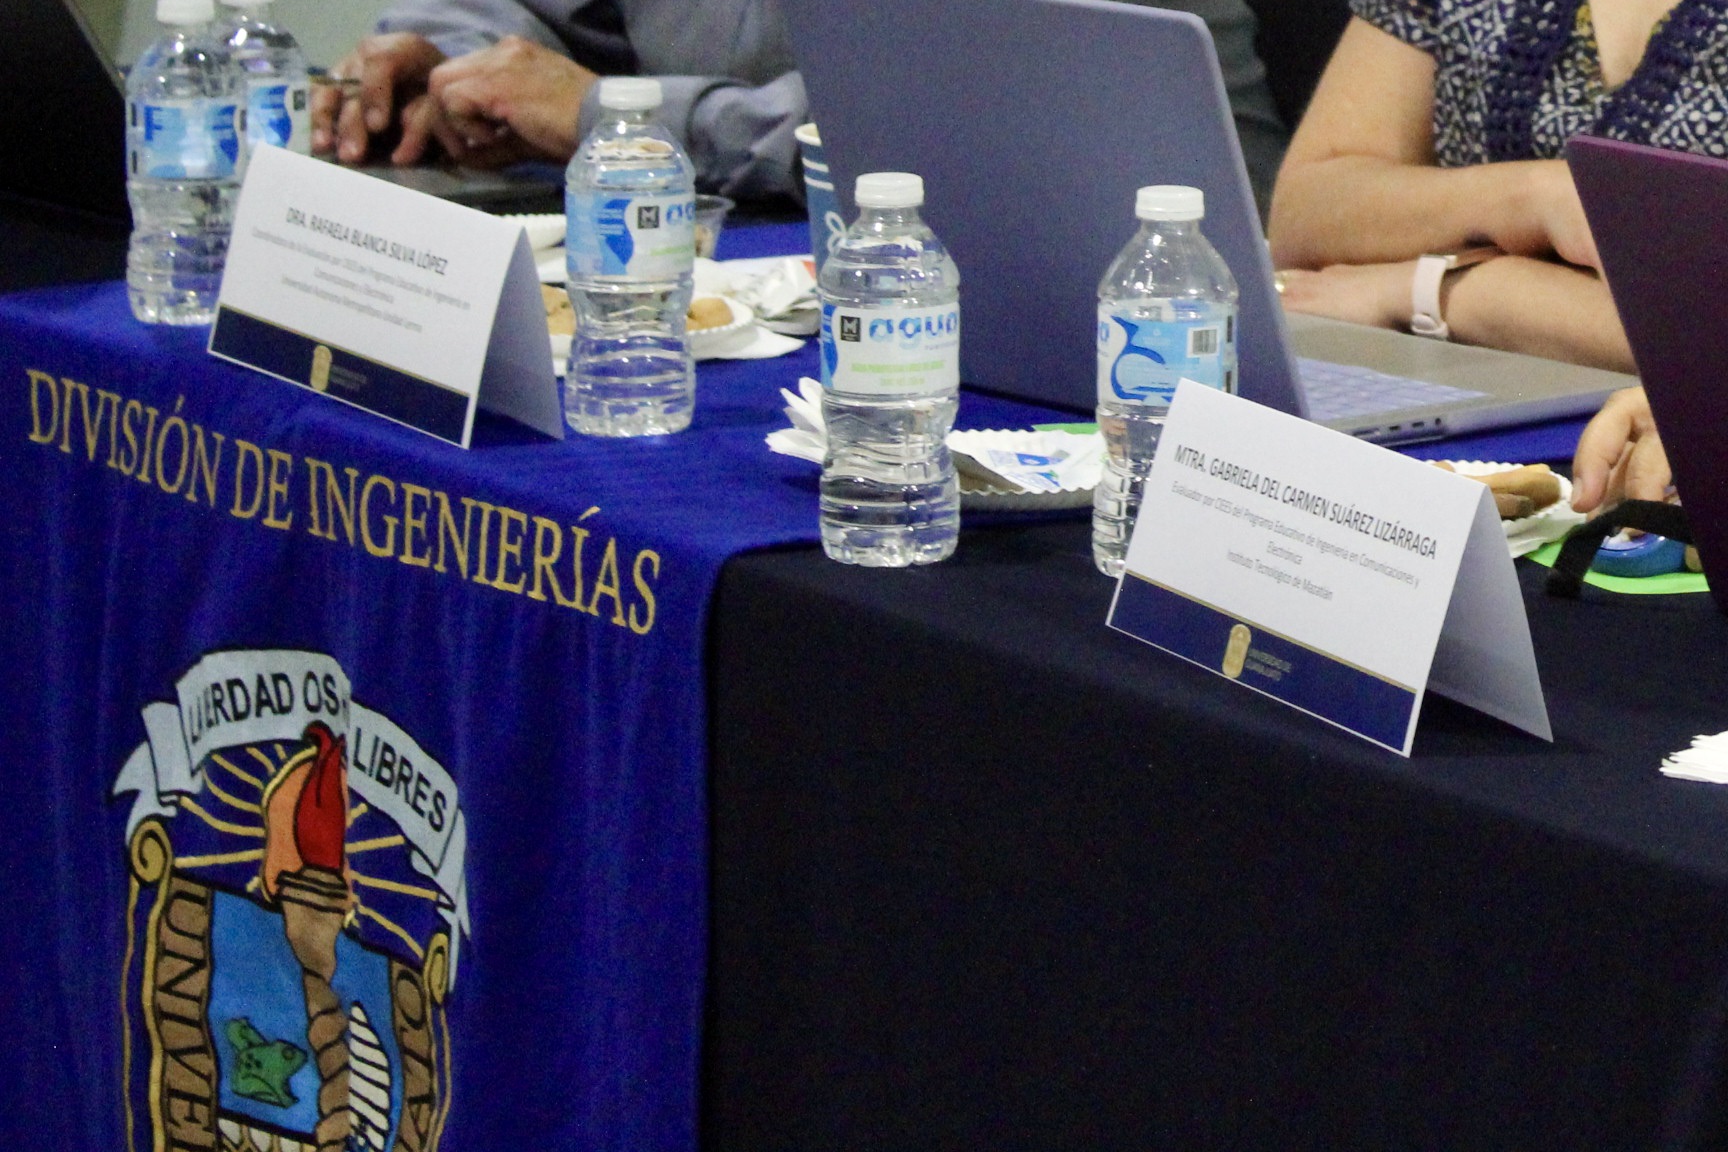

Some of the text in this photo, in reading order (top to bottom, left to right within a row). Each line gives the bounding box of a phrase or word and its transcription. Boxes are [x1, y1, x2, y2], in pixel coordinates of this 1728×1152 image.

[310, 215, 350, 240] RAFAELA
[351, 229, 387, 253] BLANCA
[389, 242, 415, 263] SILVA
[417, 249, 447, 273] LÓPEZ
[26, 369, 661, 635] DIVISIÓN DE INGENIERÍAS
[1174, 445, 1437, 558] MTRA. GABRIELA DEL CARMEN SUÁREZ LIZÁRRAGA
[303, 671, 340, 716] OS
[353, 727, 446, 832] LIBRES
[155, 890, 210, 1151] UNIVE
